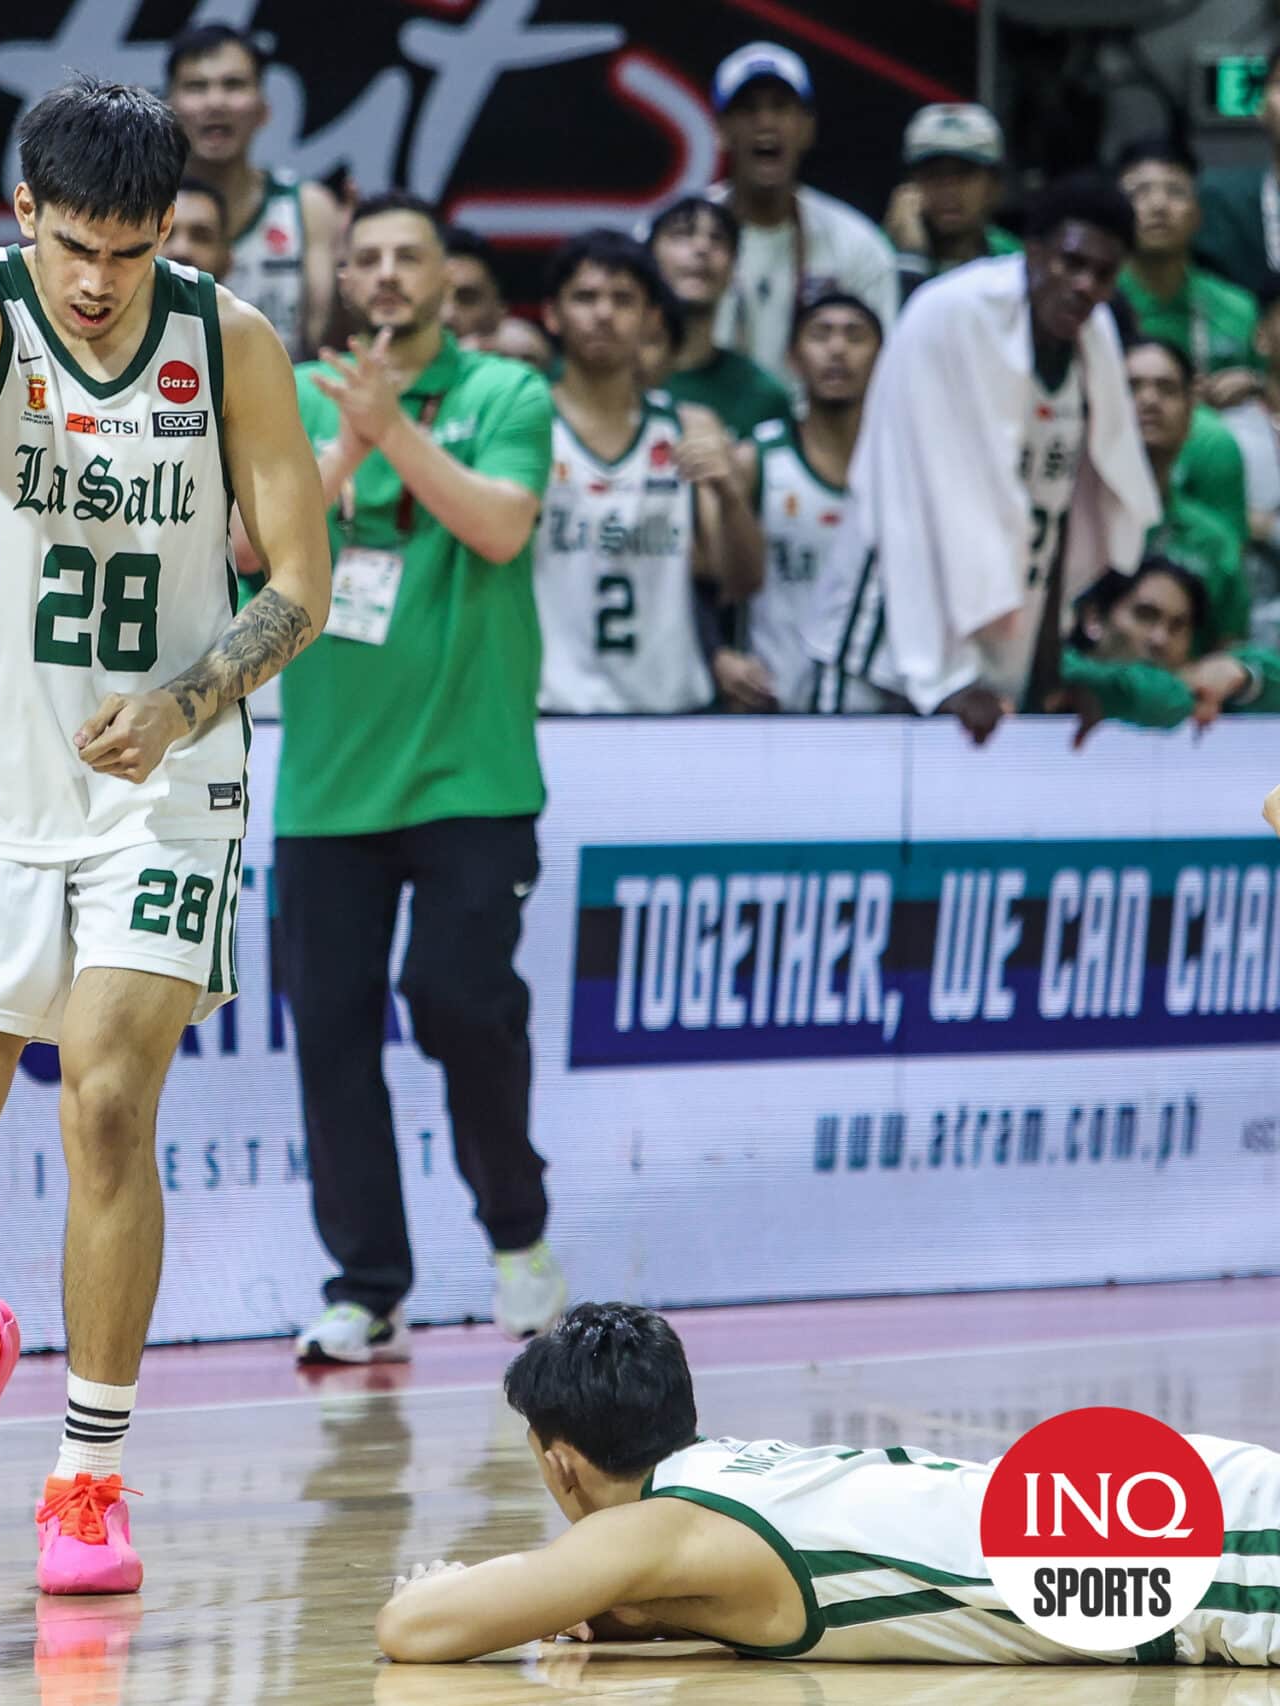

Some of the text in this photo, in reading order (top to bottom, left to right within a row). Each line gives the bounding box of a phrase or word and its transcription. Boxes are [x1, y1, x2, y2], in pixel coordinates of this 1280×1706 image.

[160, 376, 197, 388] Gazz
[163, 416, 201, 427] CWC
[96, 419, 139, 434] ICTSI
[13, 444, 196, 527] La Salle
[34, 543, 161, 672] 28
[596, 574, 635, 655] 2
[131, 868, 214, 944] 28
[614, 871, 903, 1042] TOGETHER,
[929, 867, 1027, 1022] WE
[1037, 867, 1152, 1020] CAN
[813, 1092, 1198, 1173] www.atram.com.ph
